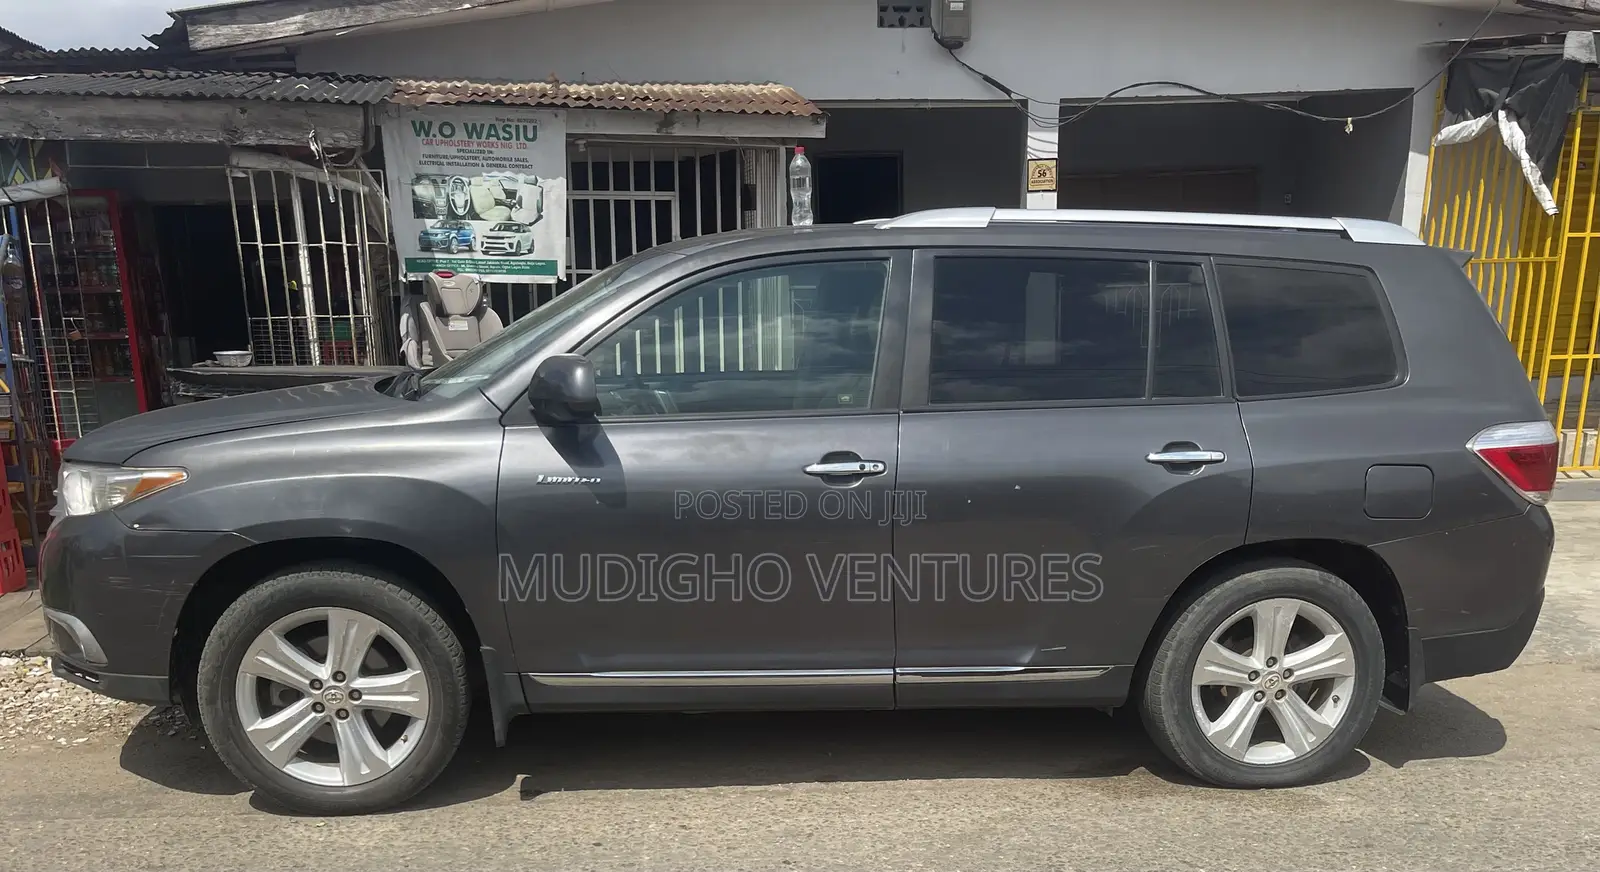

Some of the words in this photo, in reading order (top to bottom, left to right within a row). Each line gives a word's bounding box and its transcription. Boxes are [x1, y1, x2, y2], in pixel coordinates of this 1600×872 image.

[411, 120, 456, 139] W.O
[463, 122, 538, 142] WASIU
[422, 138, 434, 146] CAR
[435, 139, 475, 148] UPHOLSTERY
[476, 141, 499, 149] WORKS
[1037, 169, 1047, 177] 56
